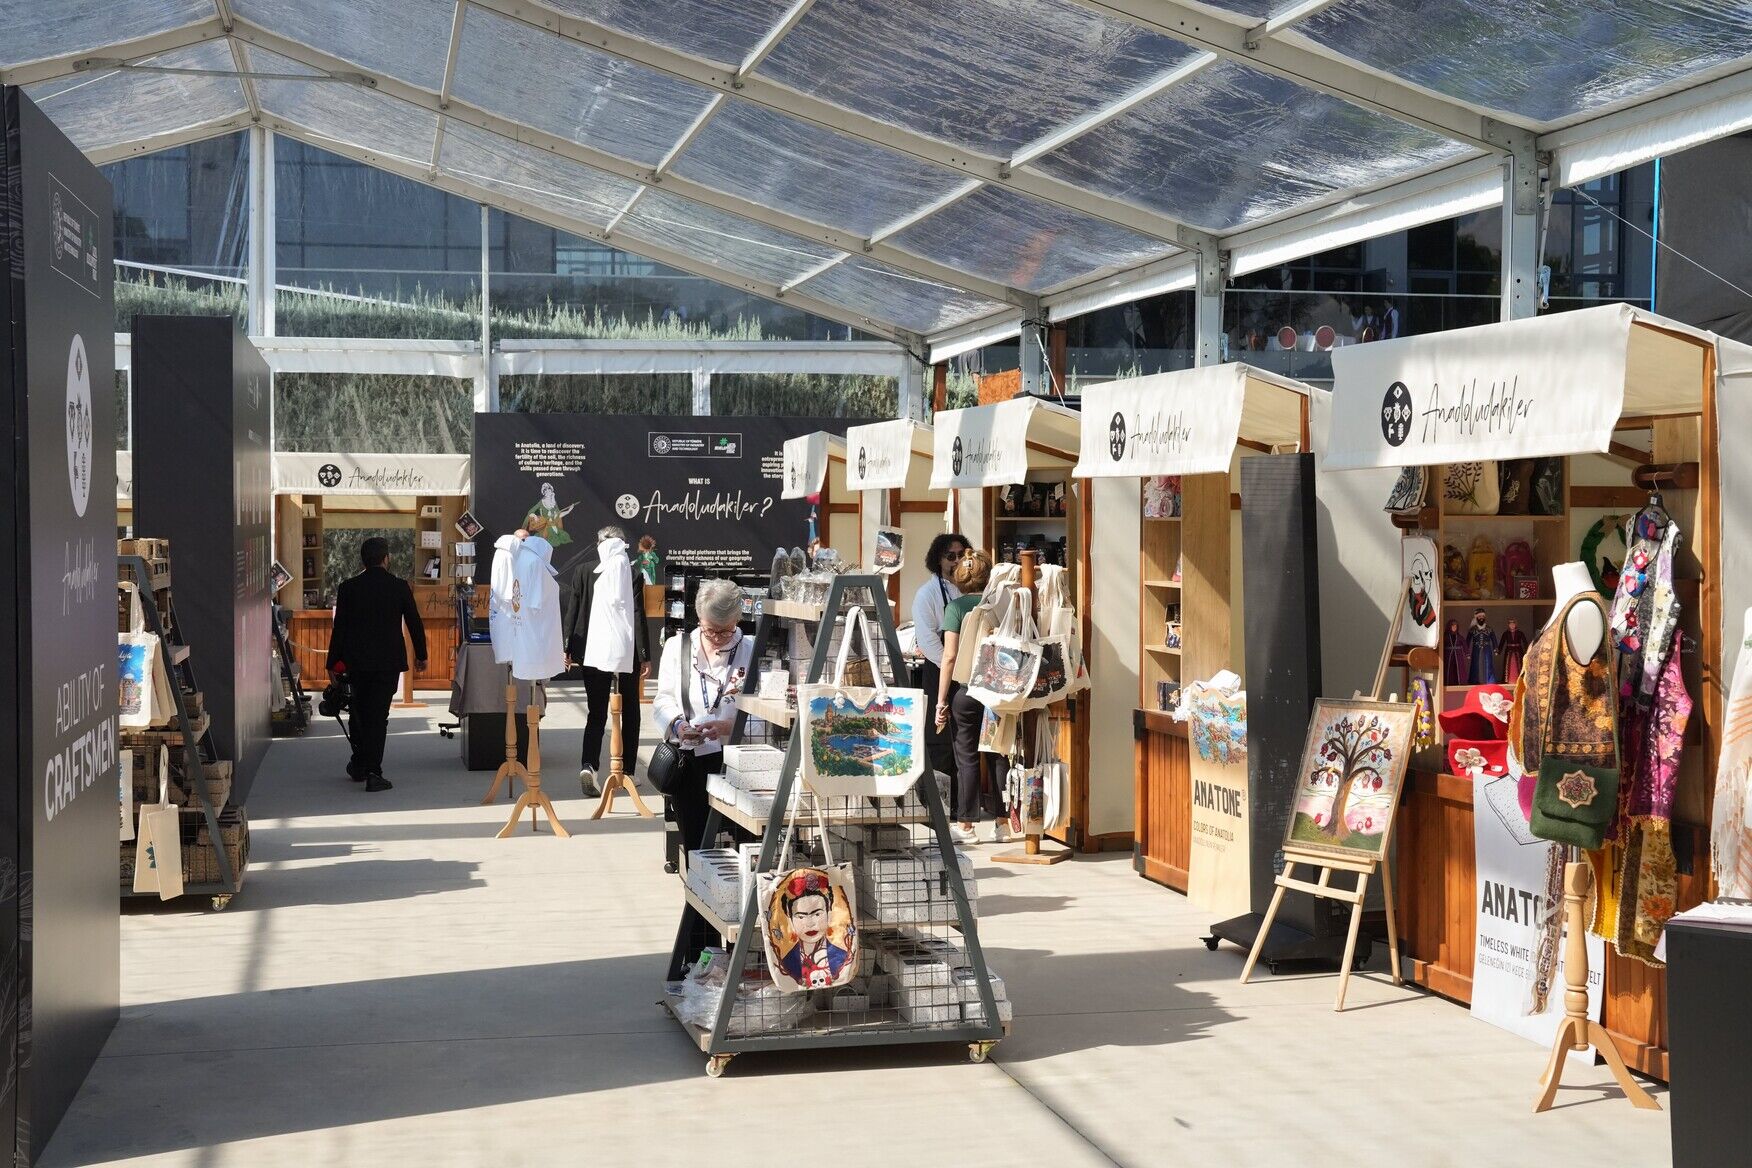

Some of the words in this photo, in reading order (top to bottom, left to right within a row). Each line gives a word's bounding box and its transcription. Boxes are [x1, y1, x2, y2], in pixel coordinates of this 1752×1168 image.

[1422, 375, 1533, 443] Anadoludakiler
[56, 669, 92, 738] ABILITY
[92, 663, 104, 711] OF
[44, 715, 115, 822] CRAFTSMEN
[1194, 779, 1242, 818] ANATONE
[1209, 825, 1215, 836] OF
[1480, 934, 1508, 955] TIMELESS
[1510, 943, 1530, 962] WHITE
[1587, 968, 1601, 985] ELT
